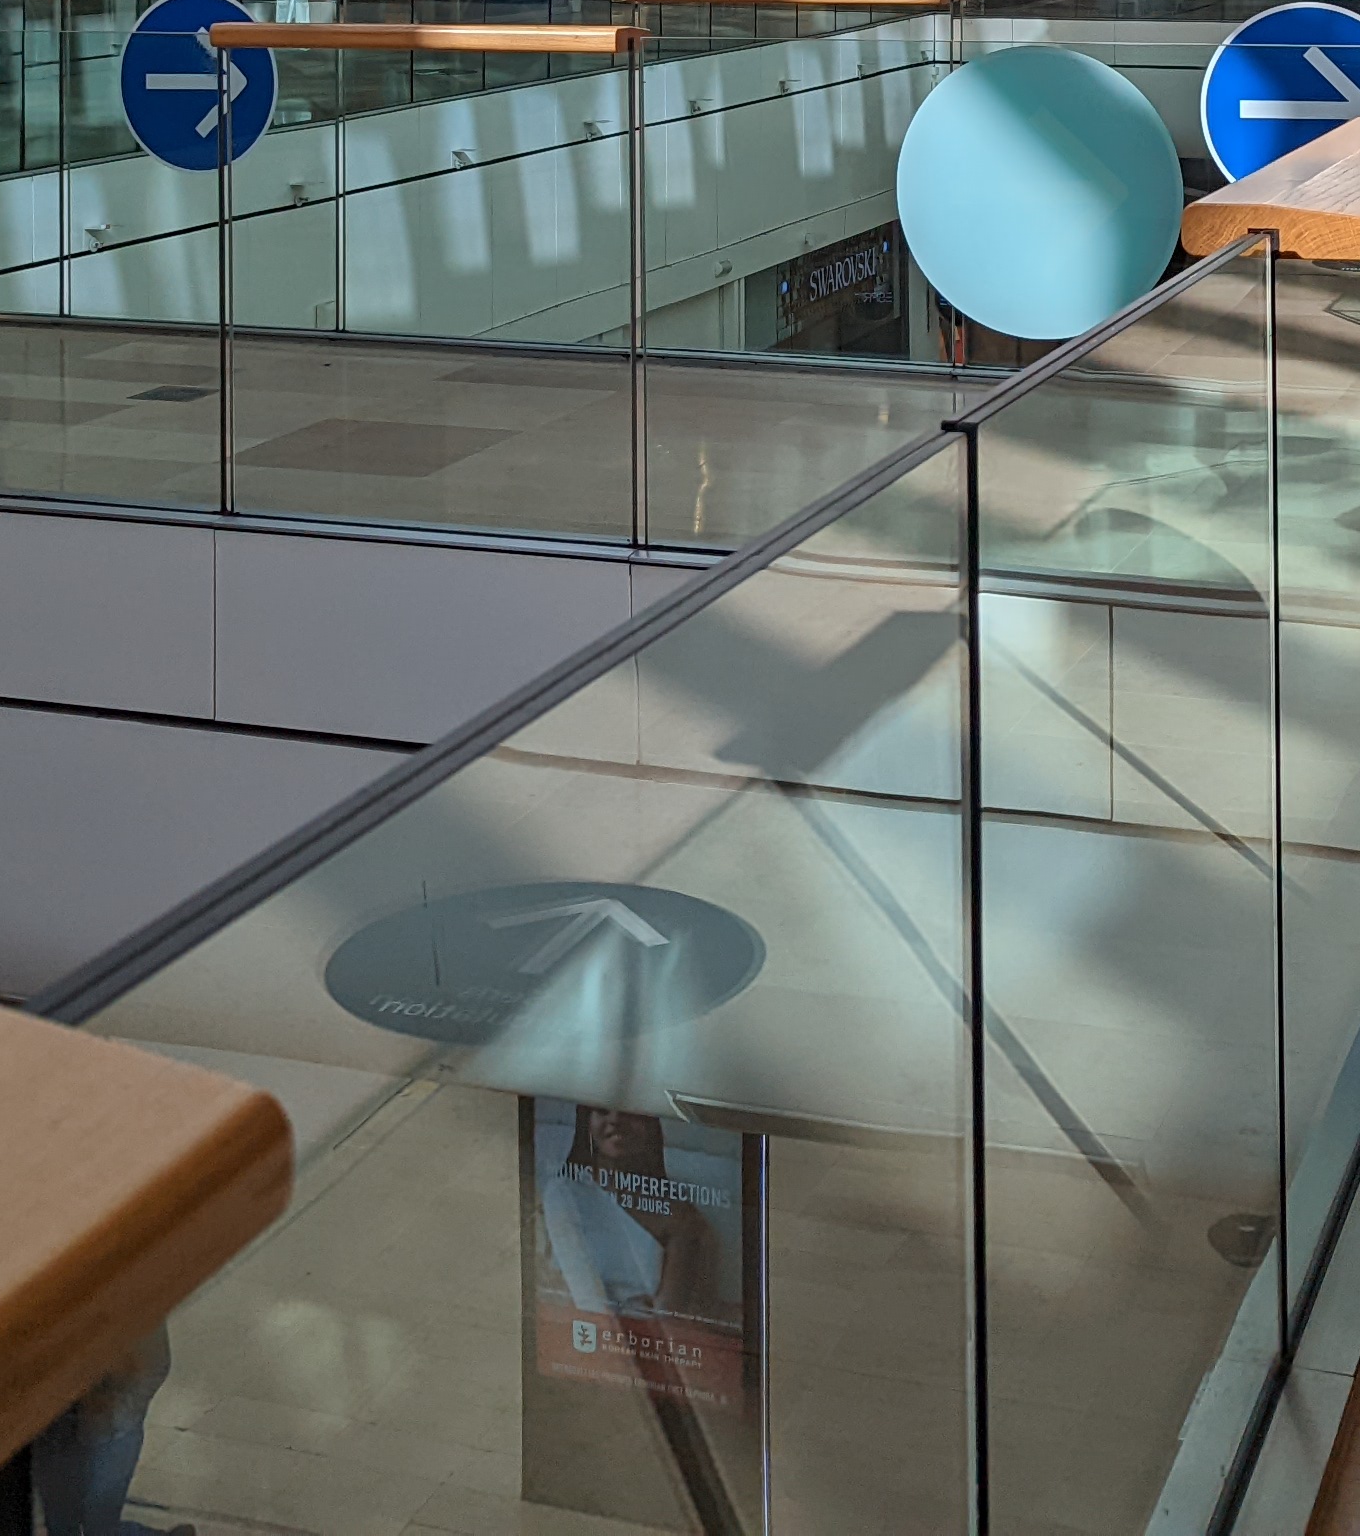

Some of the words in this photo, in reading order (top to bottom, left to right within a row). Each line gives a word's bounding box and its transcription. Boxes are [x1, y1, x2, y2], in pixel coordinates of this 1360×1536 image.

[809, 245, 877, 302] SWAROVSKI
[547, 1161, 594, 1183] OINS
[598, 1168, 731, 1210] D'IMPERFECTIONS
[620, 1193, 633, 1209] 28
[636, 1197, 673, 1216] JOURS.
[602, 1329, 703, 1359] erborian
